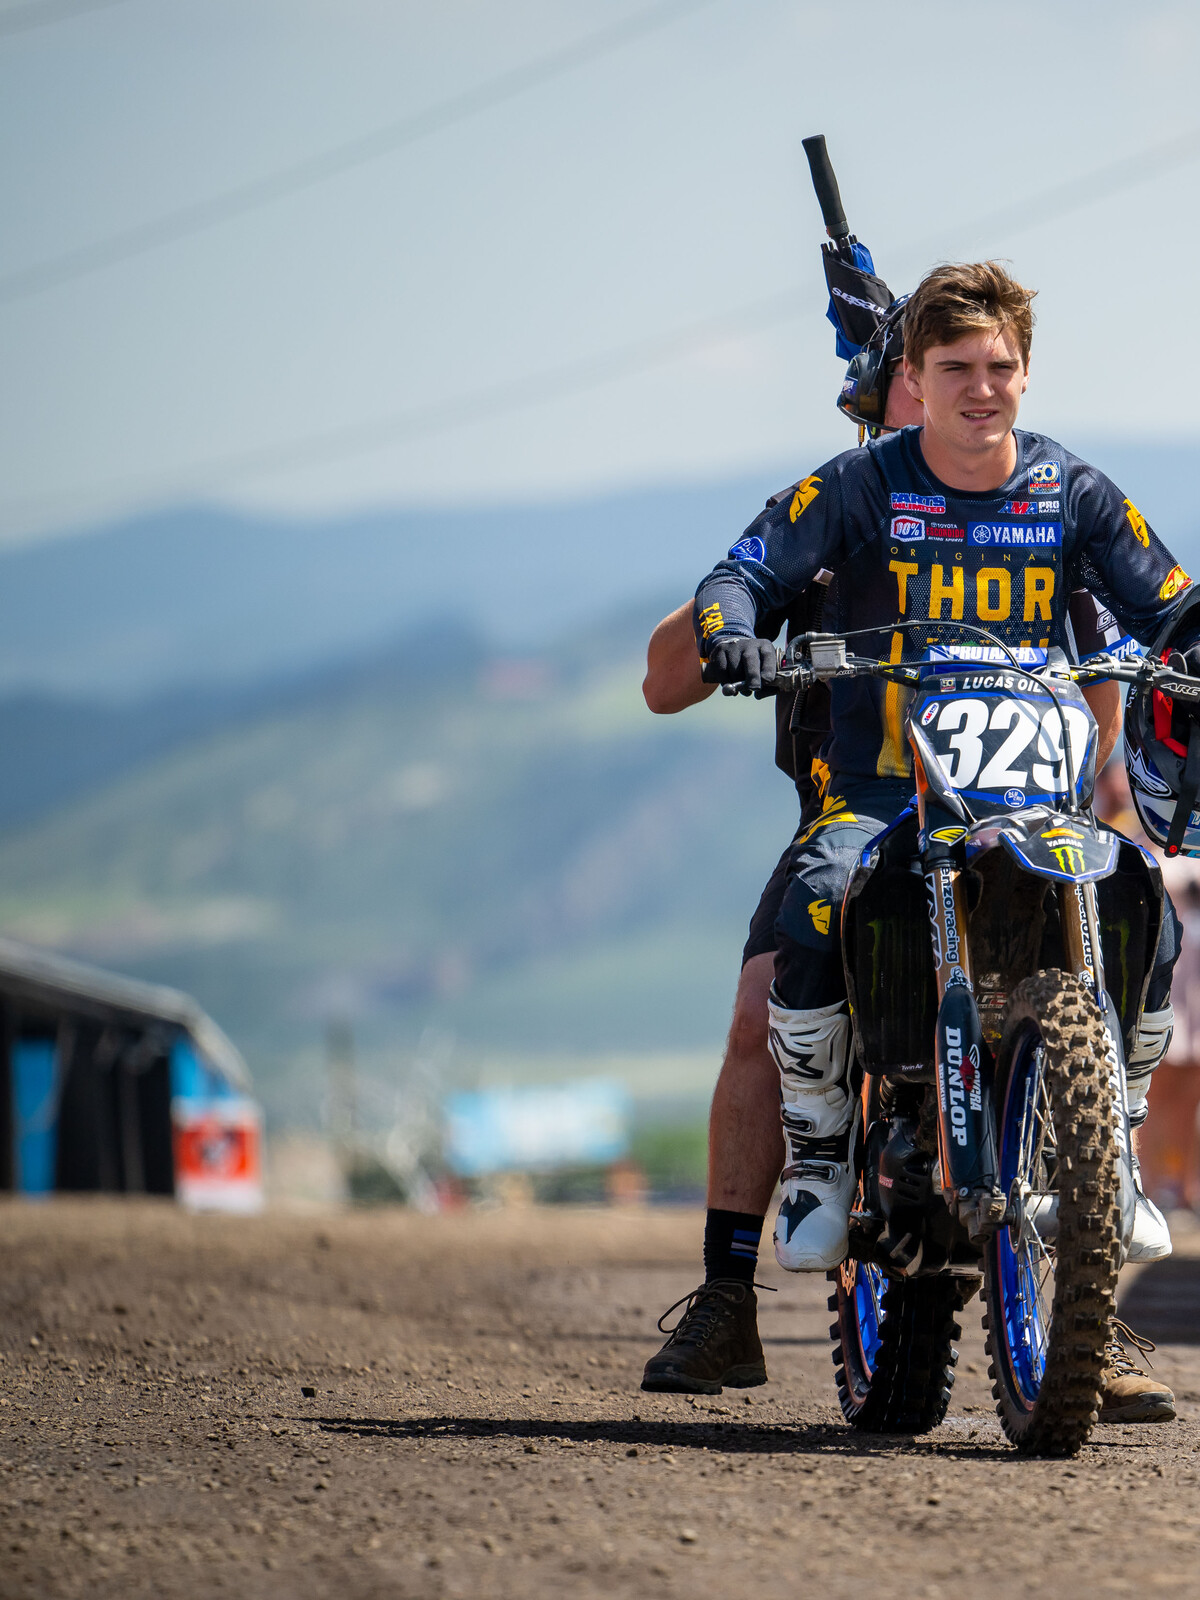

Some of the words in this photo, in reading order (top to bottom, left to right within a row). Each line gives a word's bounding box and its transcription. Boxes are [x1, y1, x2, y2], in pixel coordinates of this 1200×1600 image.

[1032, 463, 1058, 483] 50
[998, 501, 1038, 514] AMA
[1039, 501, 1060, 509] PRO
[926, 527, 965, 539] ESCONDIDO
[992, 526, 1056, 544] YAMAHA
[890, 547, 1057, 561] ORIGINAL
[888, 559, 1056, 622] THOR
[962, 676, 1014, 690] LUCAS
[1160, 682, 1200, 696] ARC
[935, 699, 1090, 793] 329
[1046, 839, 1083, 848] YAMAHA
[940, 867, 960, 964] enzoracing
[945, 1026, 968, 1147] DUNLOP
